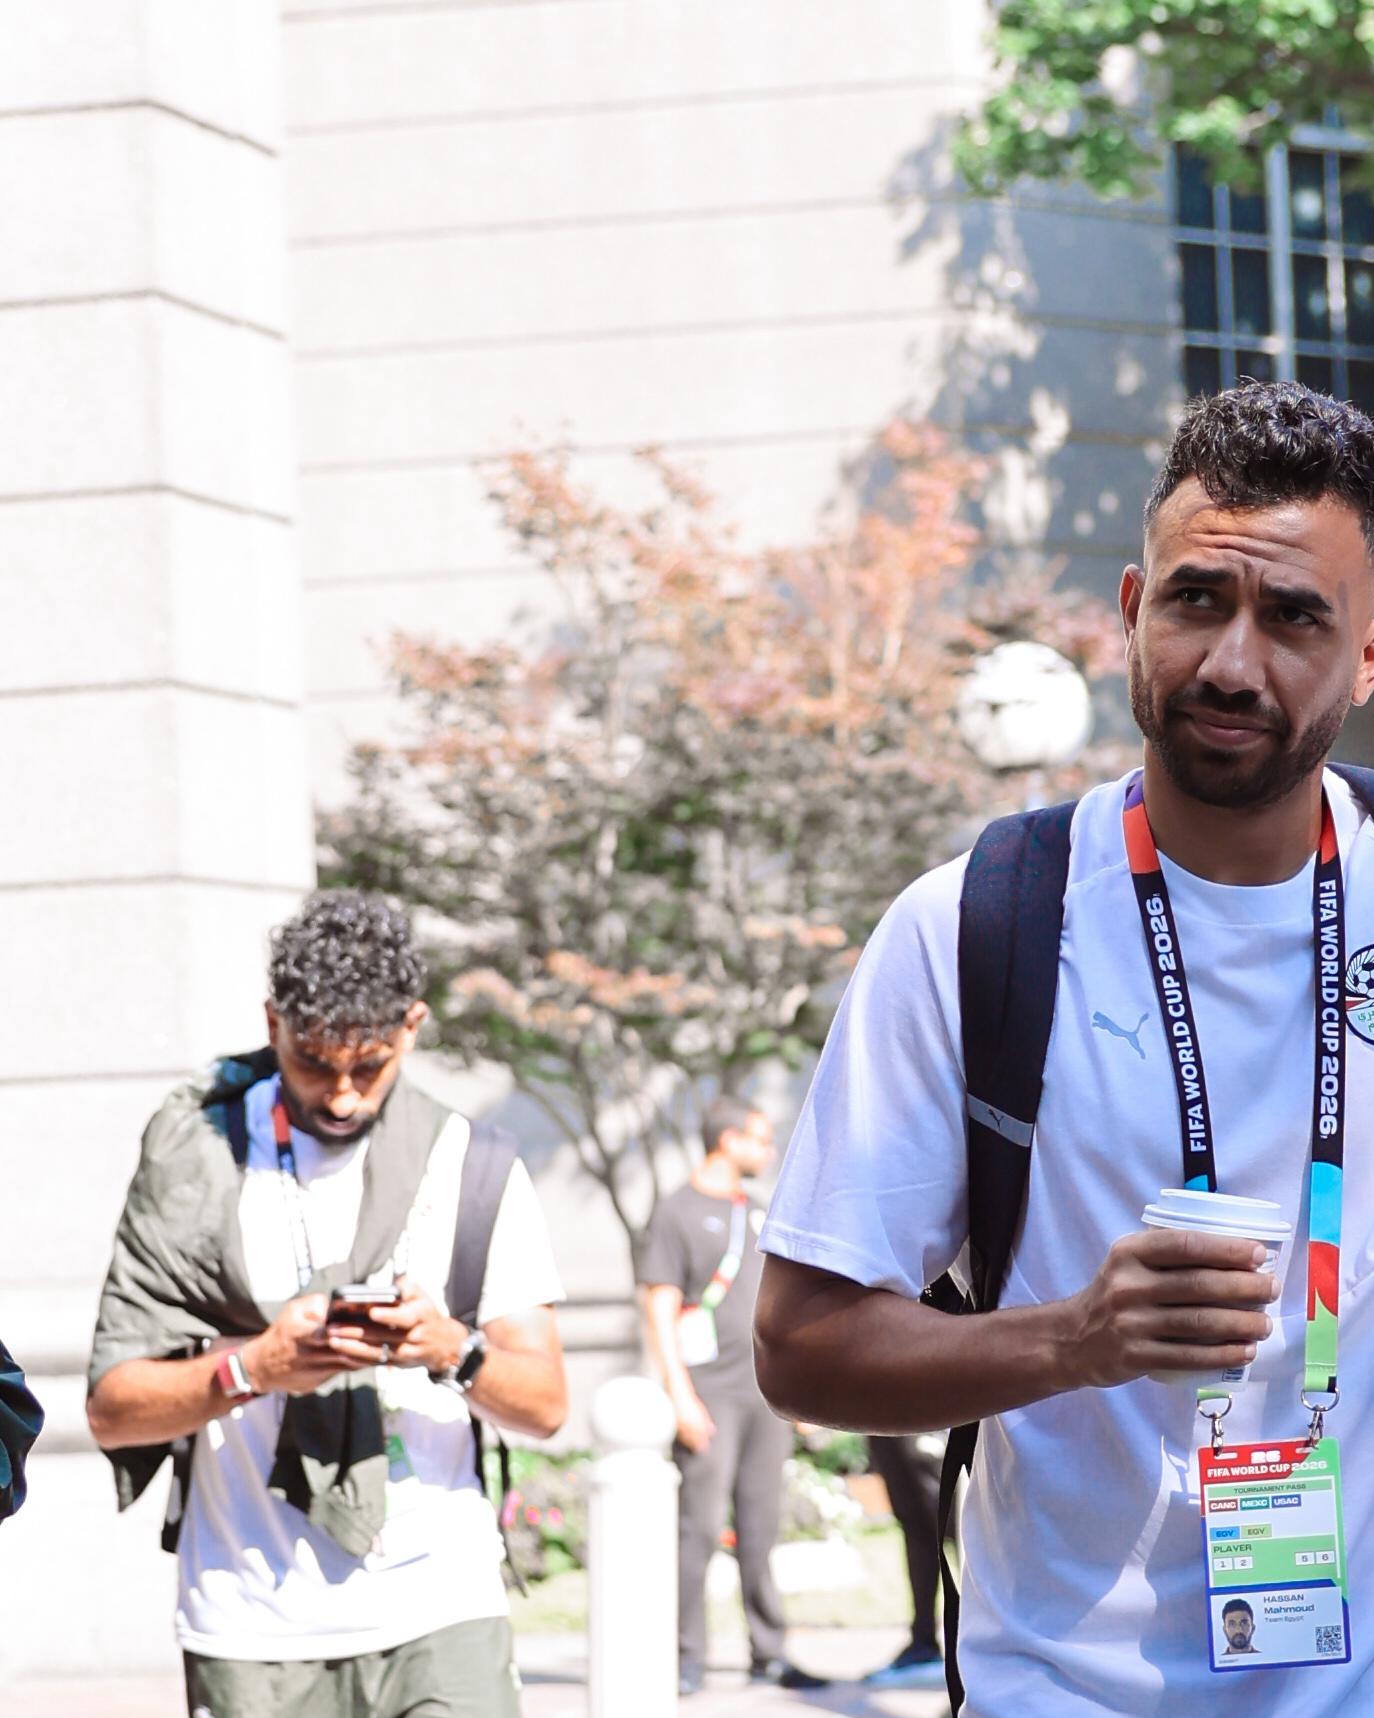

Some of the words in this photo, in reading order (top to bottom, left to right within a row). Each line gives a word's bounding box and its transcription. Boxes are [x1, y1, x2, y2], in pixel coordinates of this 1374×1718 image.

[1319, 879, 1338, 922] FIFA
[1145, 896, 1177, 972] 2026
[1320, 924, 1339, 1004] WORLD
[1162, 974, 1186, 1018] CUP
[1321, 1007, 1339, 1053] CUP
[1172, 1021, 1201, 1101] WORLD
[1319, 1055, 1340, 1136] 2026
[1186, 1103, 1207, 1153] FIFA
[1207, 1467, 1230, 1478] FIFA
[1230, 1464, 1268, 1476] WORLD
[1269, 1462, 1291, 1473] CUP
[1291, 1460, 1328, 1472] 2026
[1234, 1484, 1286, 1494] TOURNAMENT
[1213, 1543, 1252, 1553] PLAYER
[1247, 1527, 1265, 1536] EGY
[1264, 1604, 1315, 1614] Mahmoud
